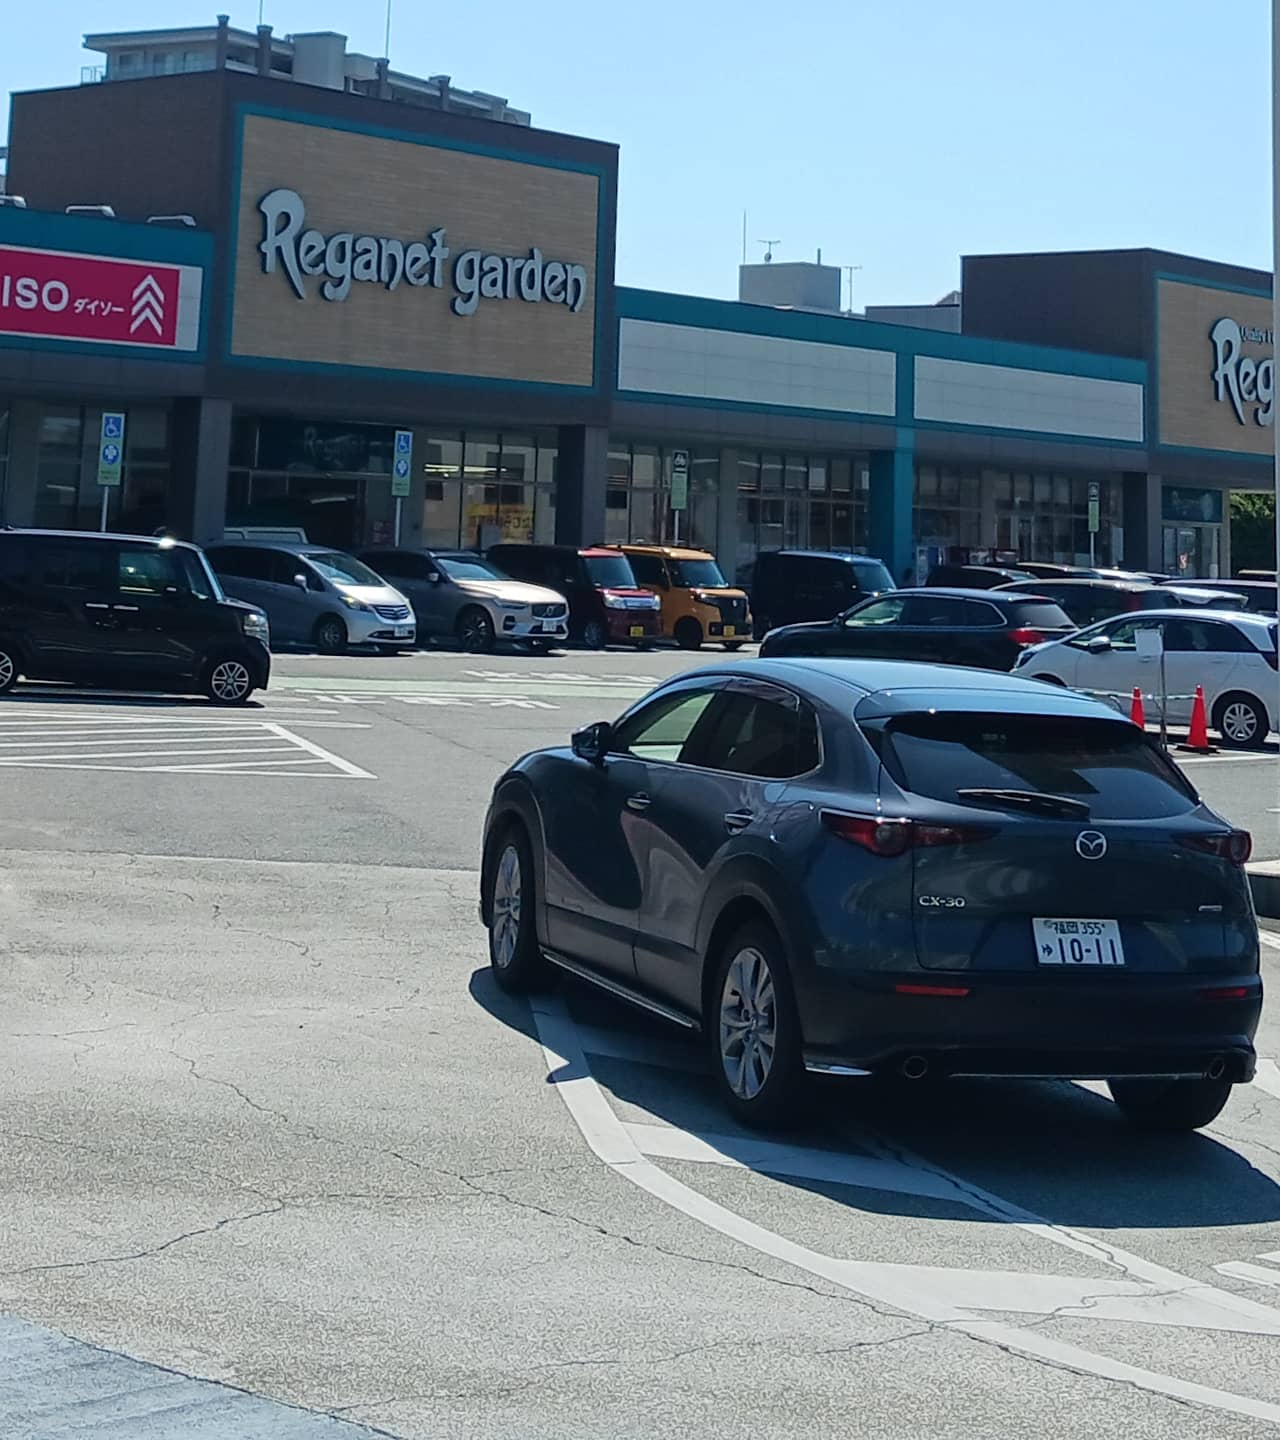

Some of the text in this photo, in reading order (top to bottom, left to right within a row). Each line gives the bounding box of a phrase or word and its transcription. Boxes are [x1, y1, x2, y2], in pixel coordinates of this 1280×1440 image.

[258, 188, 587, 316] Reganet garden
[73, 297, 124, 316] ダイソー
[919, 895, 966, 908] CX-30
[1080, 921, 1102, 935] 355
[1057, 937, 1117, 964] 10-11
